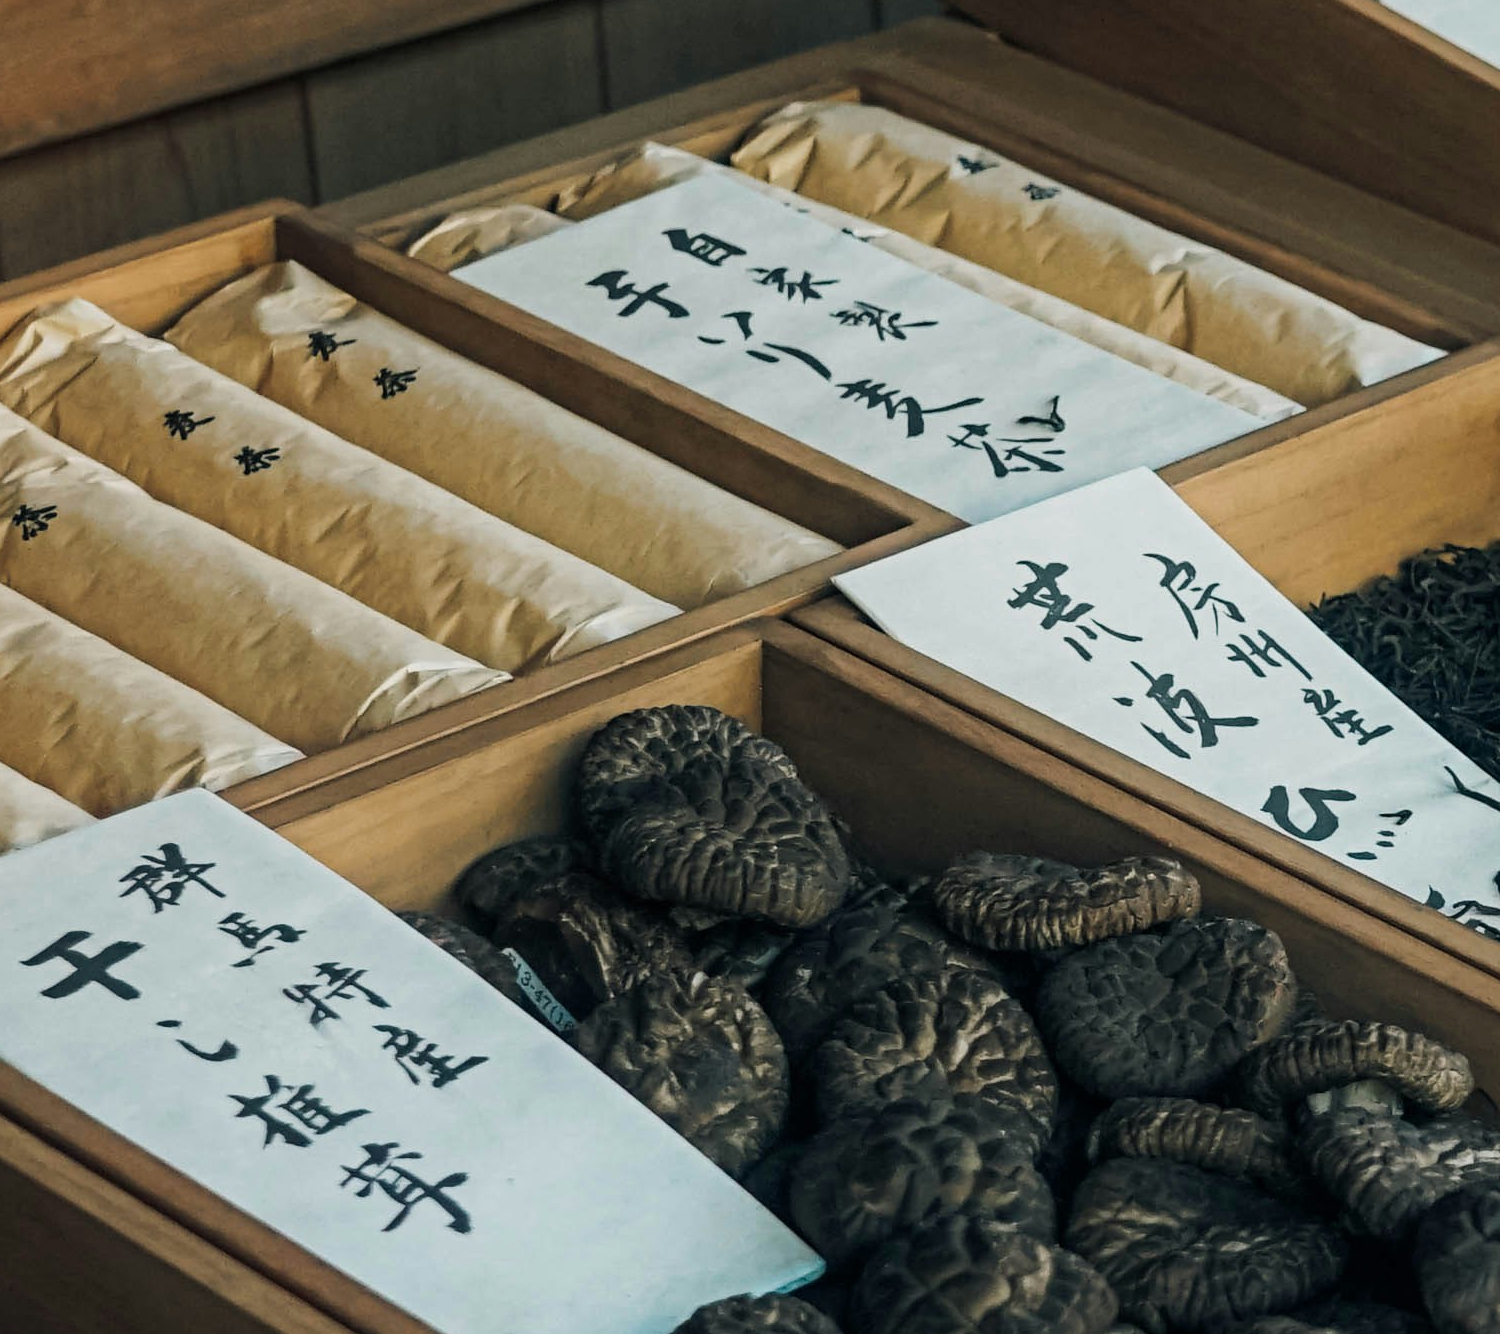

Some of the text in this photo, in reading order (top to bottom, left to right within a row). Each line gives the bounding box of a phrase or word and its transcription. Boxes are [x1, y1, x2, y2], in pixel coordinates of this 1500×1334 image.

[662, 227, 938, 341] 自家製
[20, 930, 473, 1234] 干し椎茸
[120, 843, 489, 1088] 群馬特産
